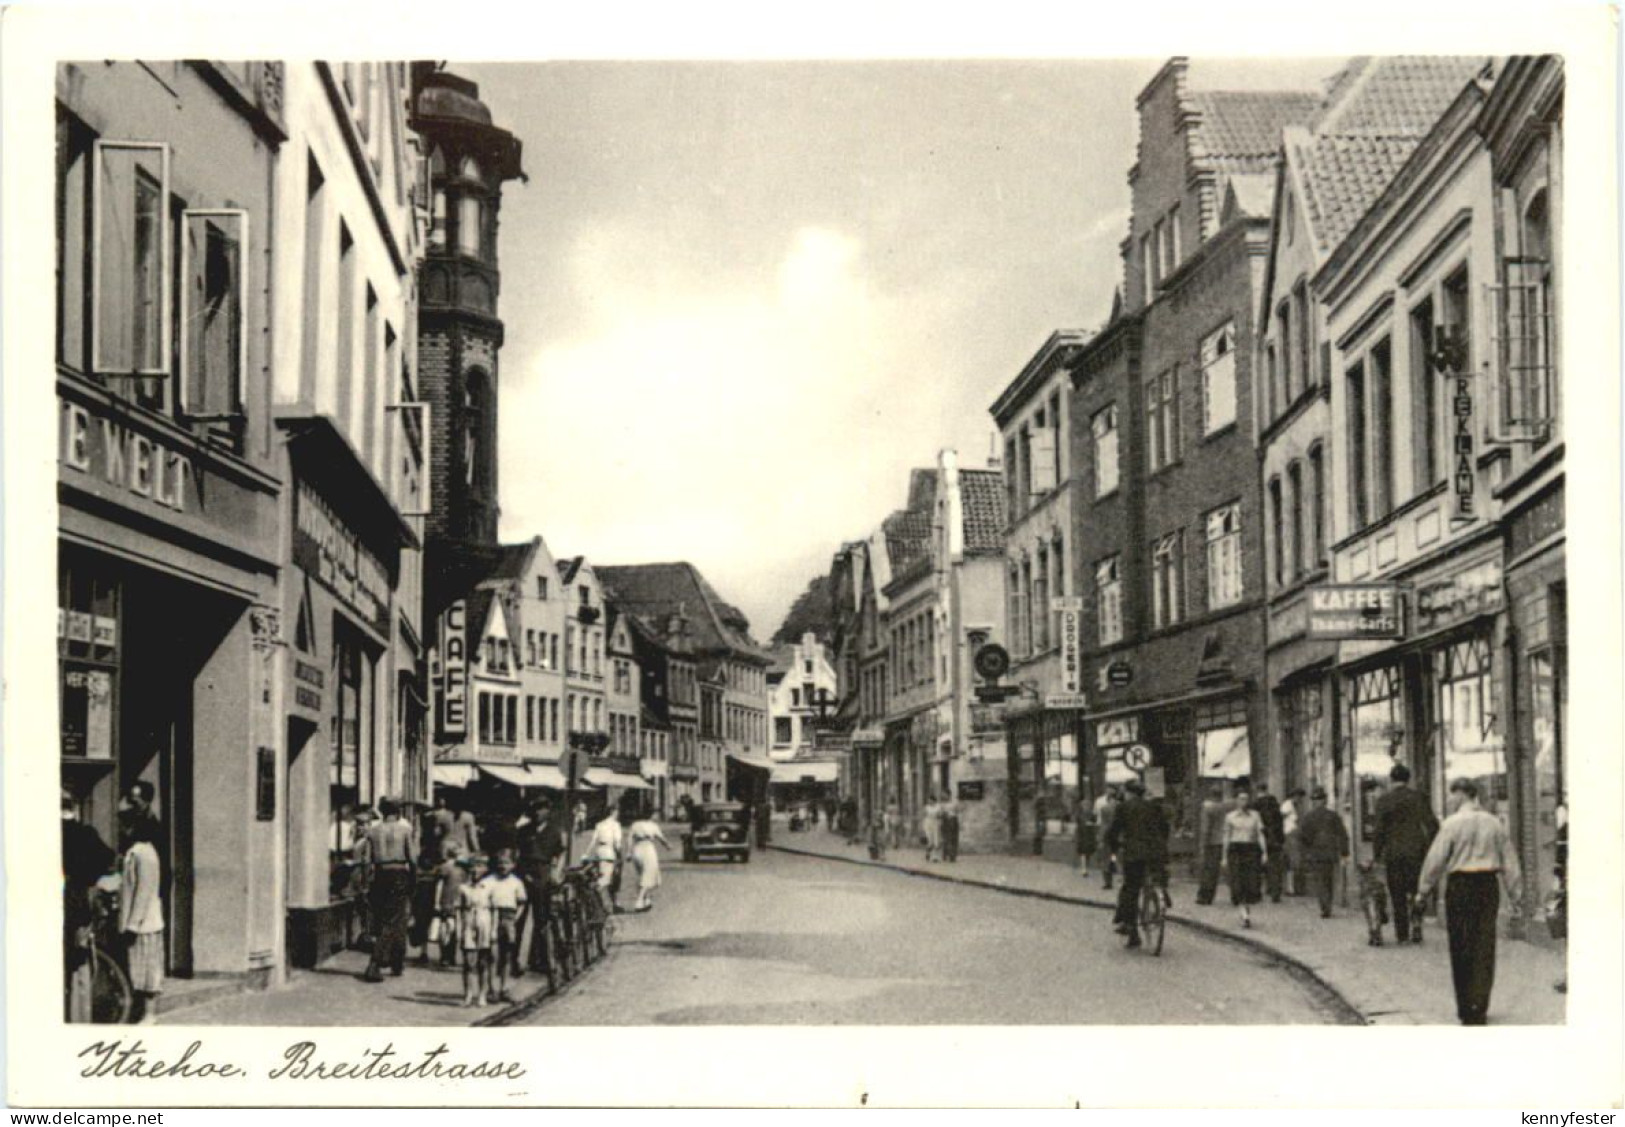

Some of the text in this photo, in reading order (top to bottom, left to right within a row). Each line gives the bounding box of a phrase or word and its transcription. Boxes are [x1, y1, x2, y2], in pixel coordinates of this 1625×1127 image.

[101, 417, 191, 513] WELT
[1454, 379, 1474, 513] REKLAME
[1312, 590, 1394, 610] KAFFEE
